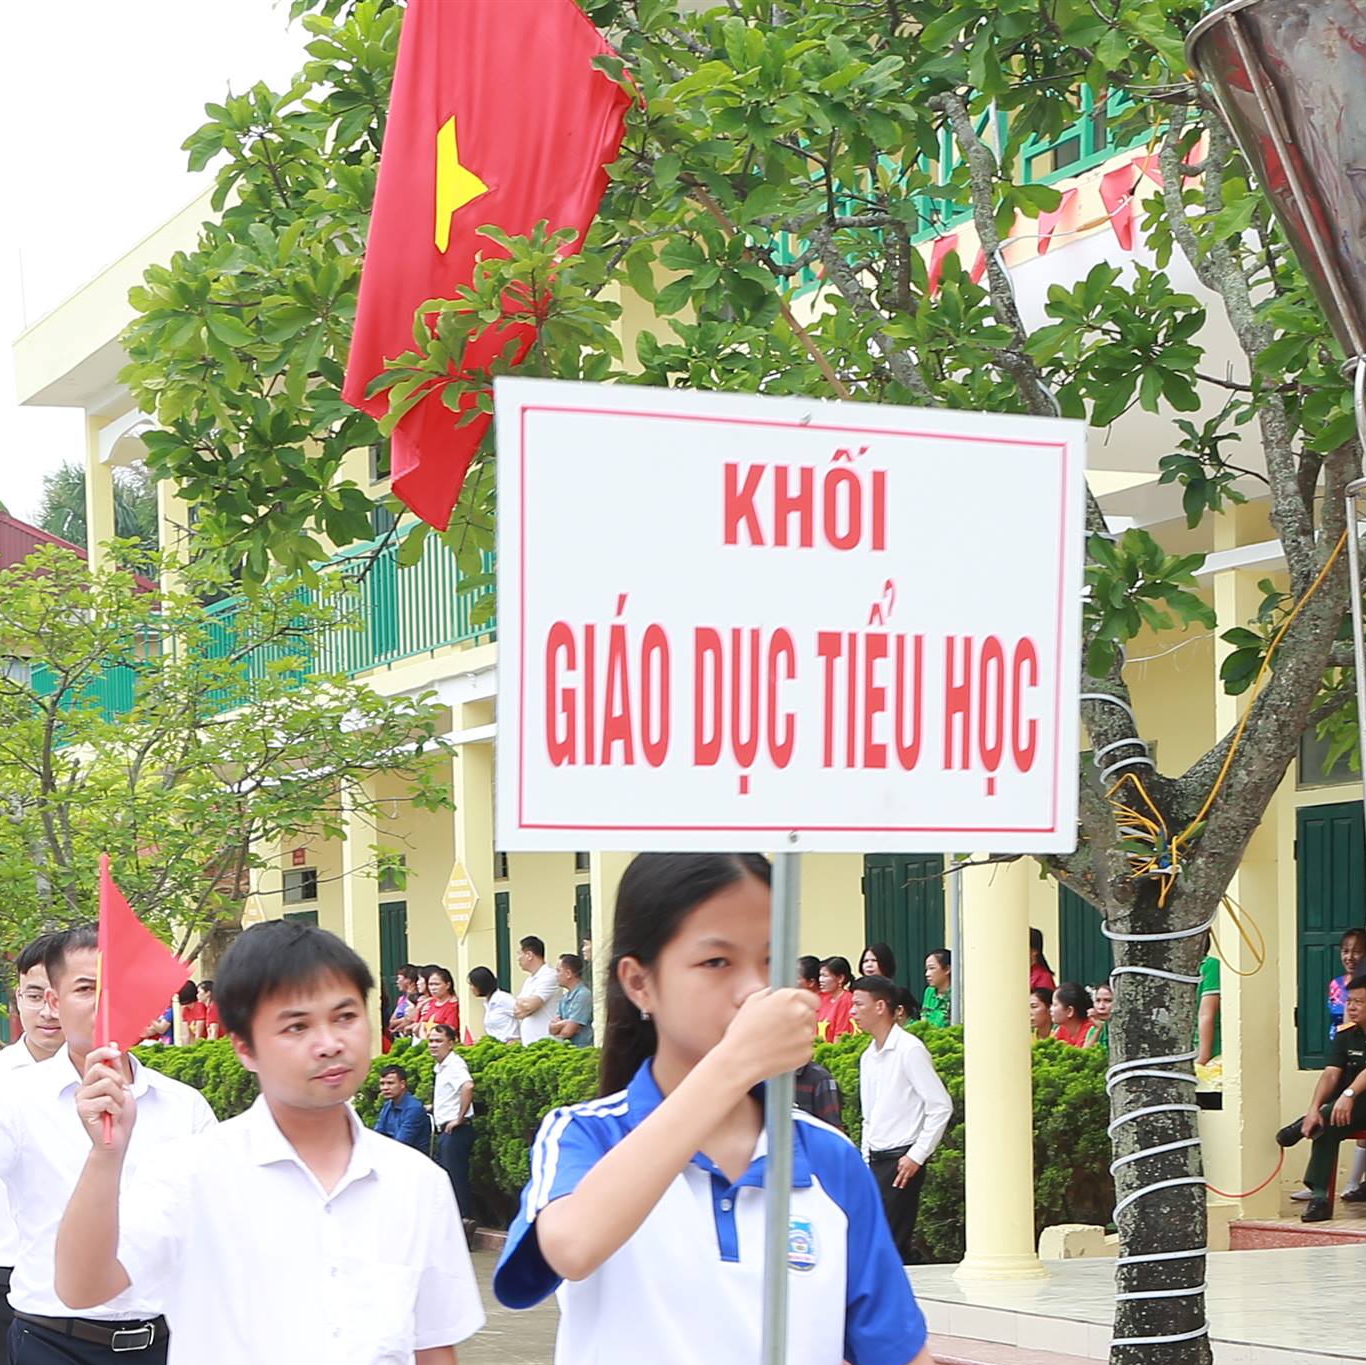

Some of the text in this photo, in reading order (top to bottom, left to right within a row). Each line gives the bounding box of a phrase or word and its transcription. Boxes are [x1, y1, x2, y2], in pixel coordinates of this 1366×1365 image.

[724, 447, 887, 551] KHỐI
[545, 579, 1040, 797] GIÁO DỤC TIỂU HỌC
